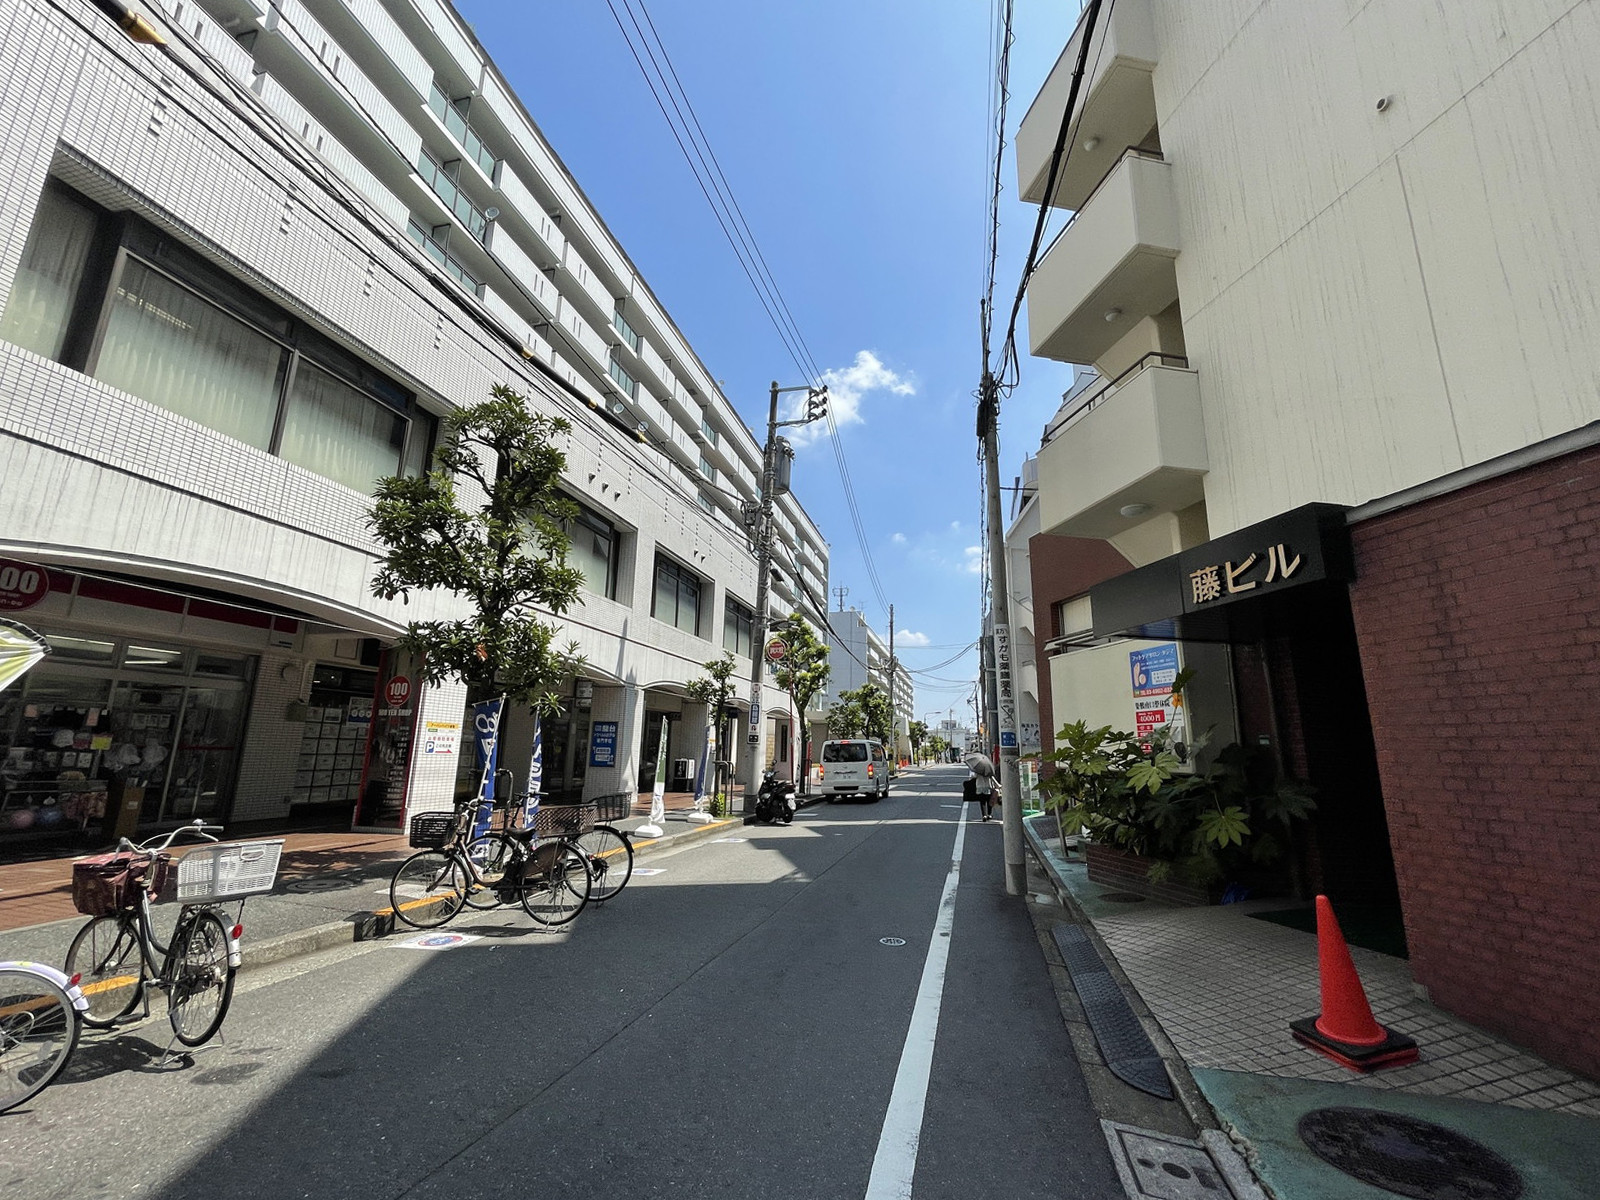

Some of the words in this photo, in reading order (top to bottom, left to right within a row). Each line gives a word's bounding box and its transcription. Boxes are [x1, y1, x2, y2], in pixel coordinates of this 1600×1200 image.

[0, 566, 40, 594] 00
[1189, 543, 1300, 604] 藤ビル
[390, 682, 408, 696] 100
